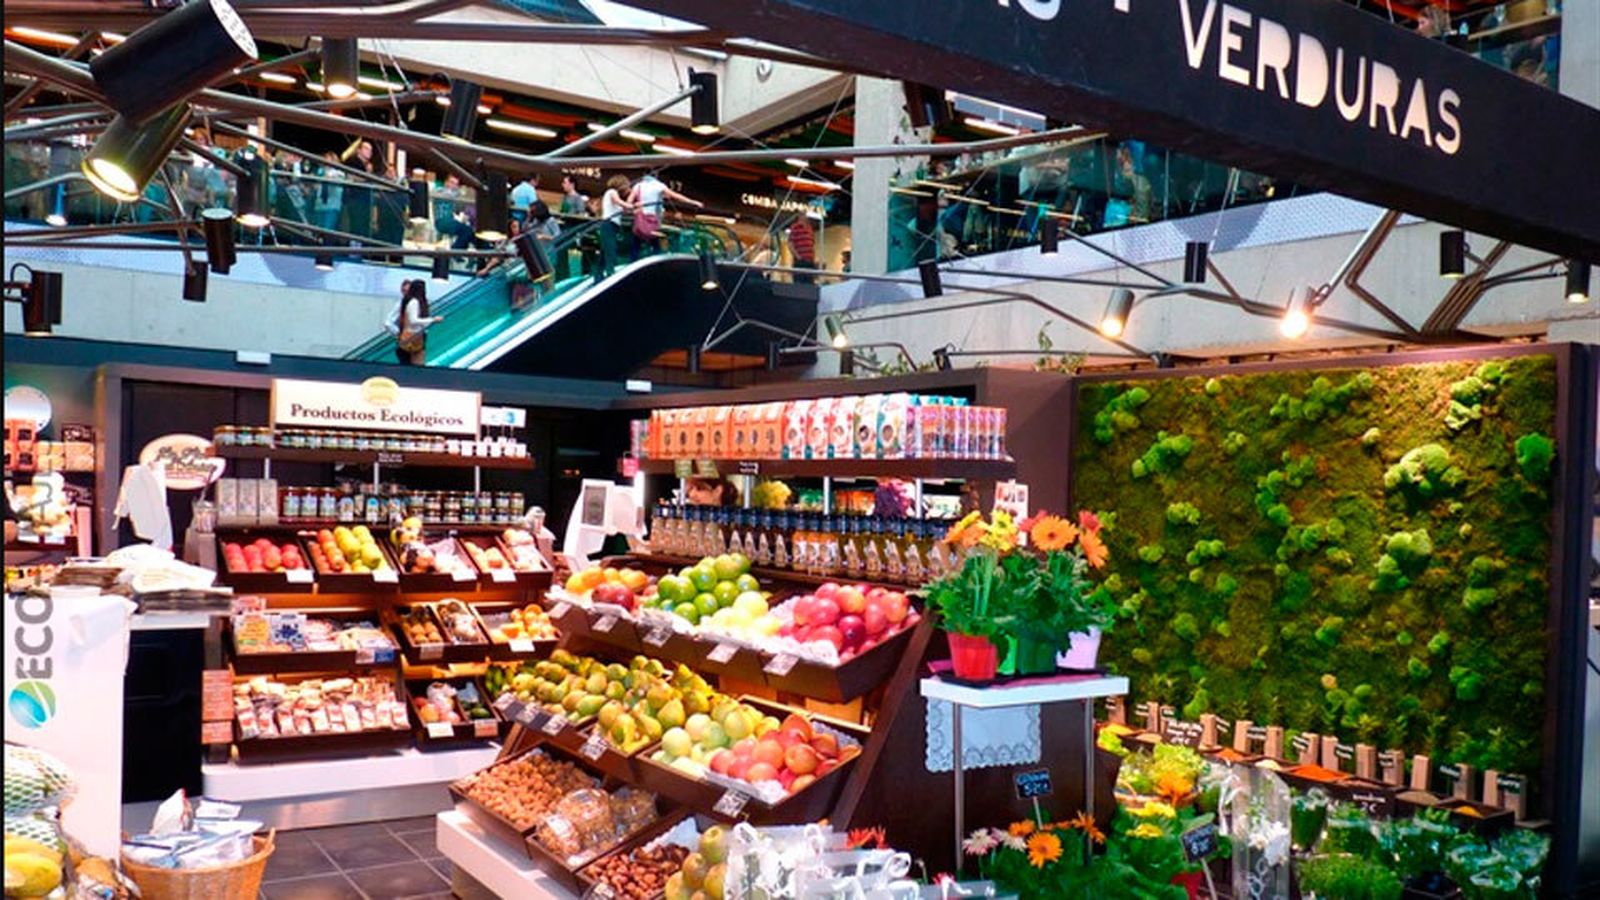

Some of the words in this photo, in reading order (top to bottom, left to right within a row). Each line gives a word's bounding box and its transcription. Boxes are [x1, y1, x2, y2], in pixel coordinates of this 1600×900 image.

[1180, 0, 1461, 154] VERDURAS
[290, 403, 376, 421] Productos
[380, 409, 464, 427] Ecológicos
